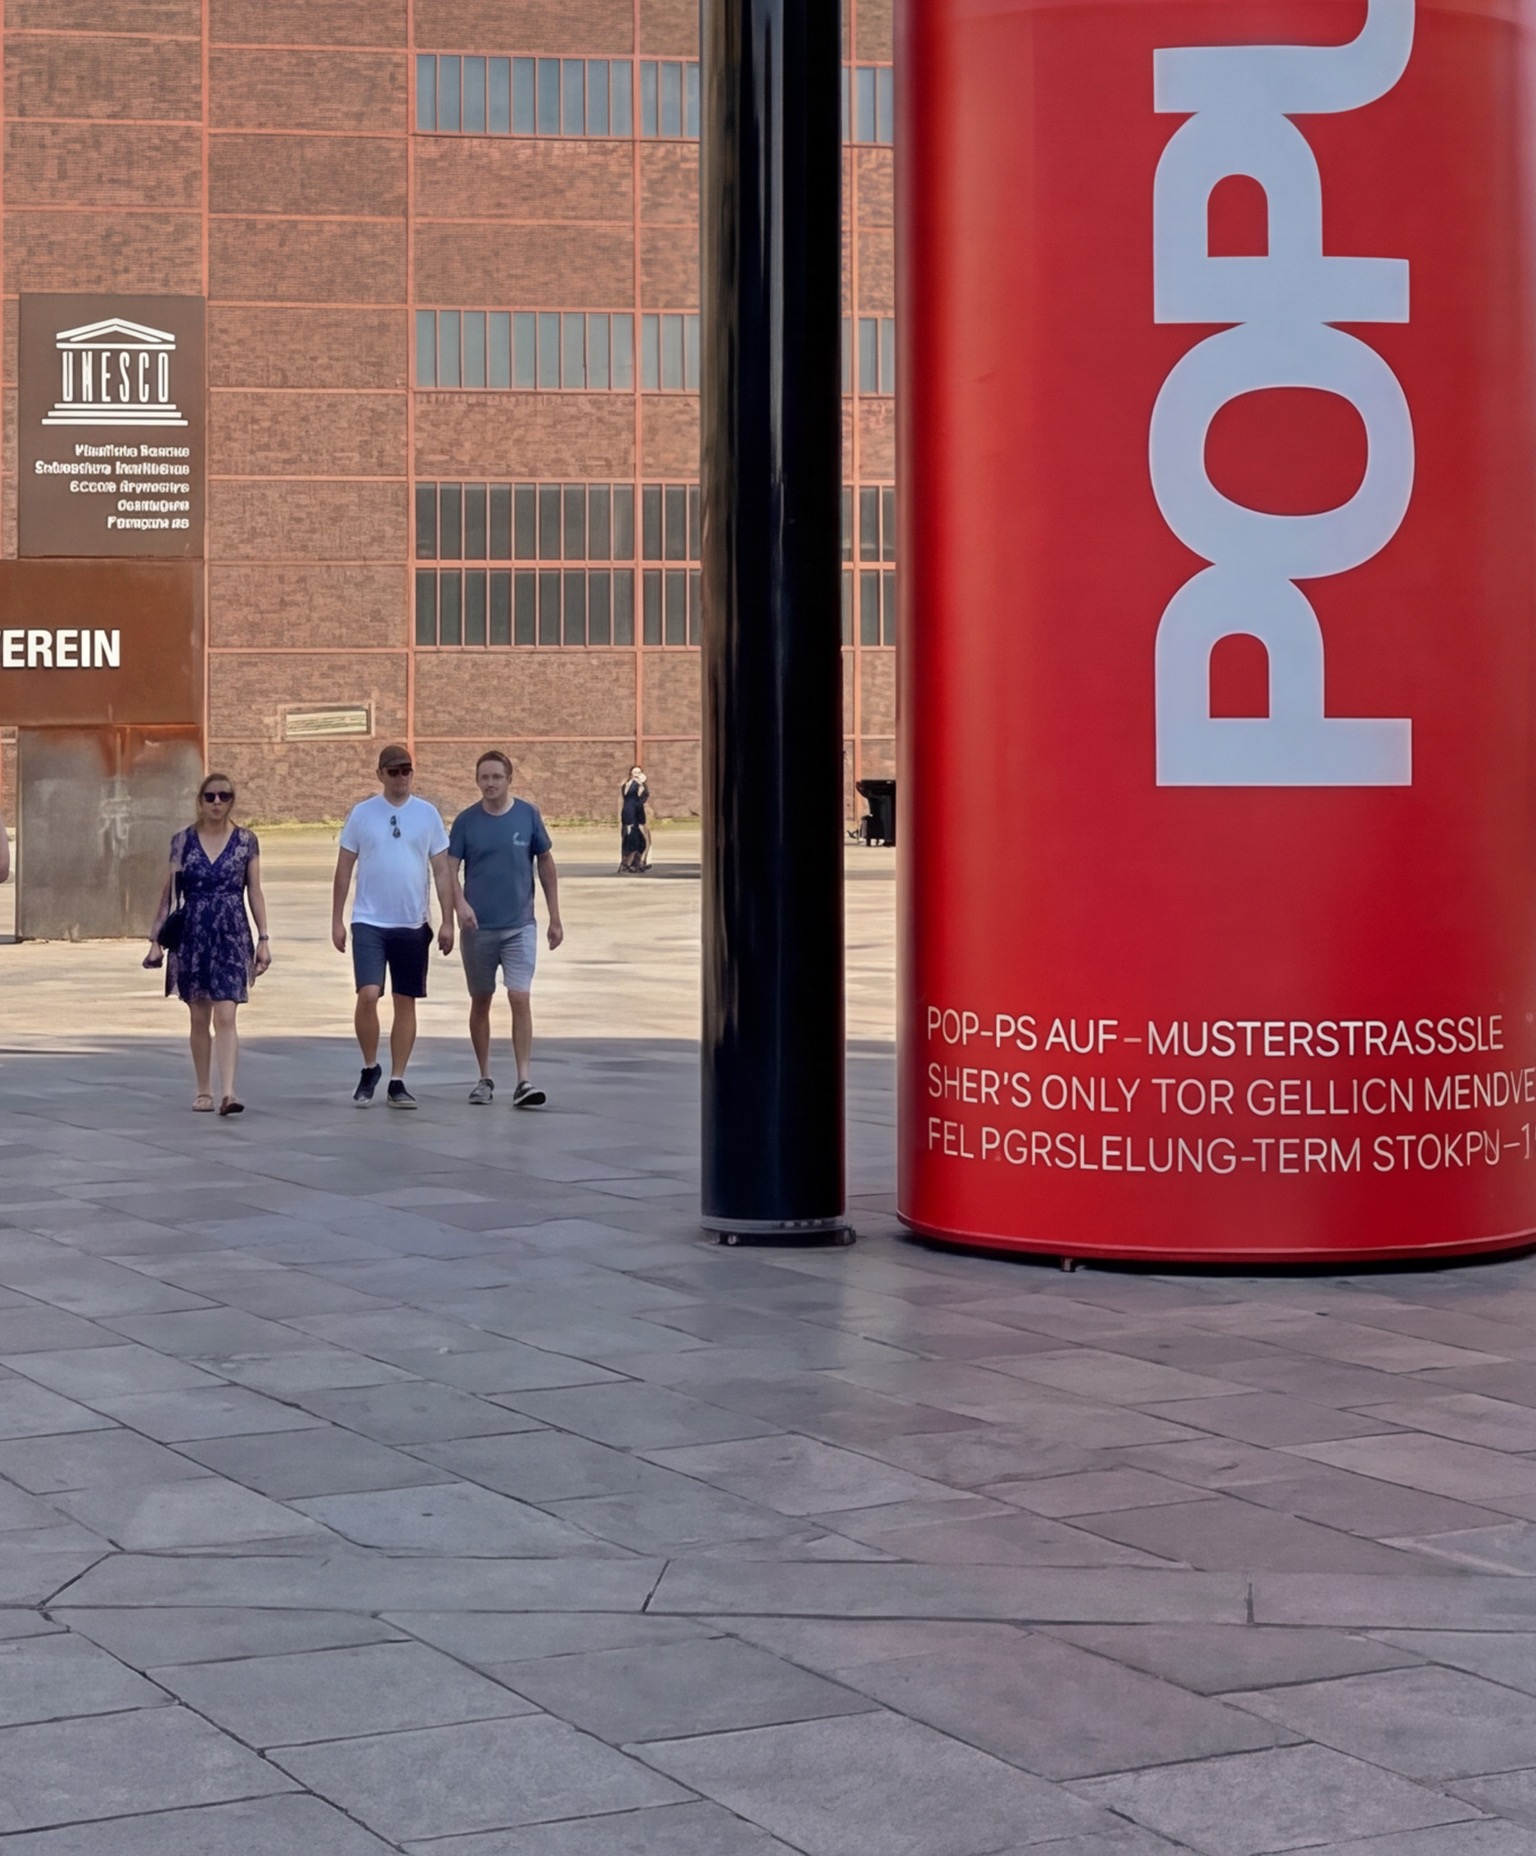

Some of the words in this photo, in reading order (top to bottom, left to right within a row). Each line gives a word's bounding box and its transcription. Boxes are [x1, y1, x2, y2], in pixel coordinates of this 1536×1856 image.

[62, 350, 169, 403] UNESCO
[927, 1062, 1033, 1109] SHER'S
[1041, 1073, 1141, 1112] ONLY
[1150, 1078, 1234, 1115] TOR
[1424, 1065, 1536, 1112] MENDVE
[927, 1116, 975, 1159] FEL
